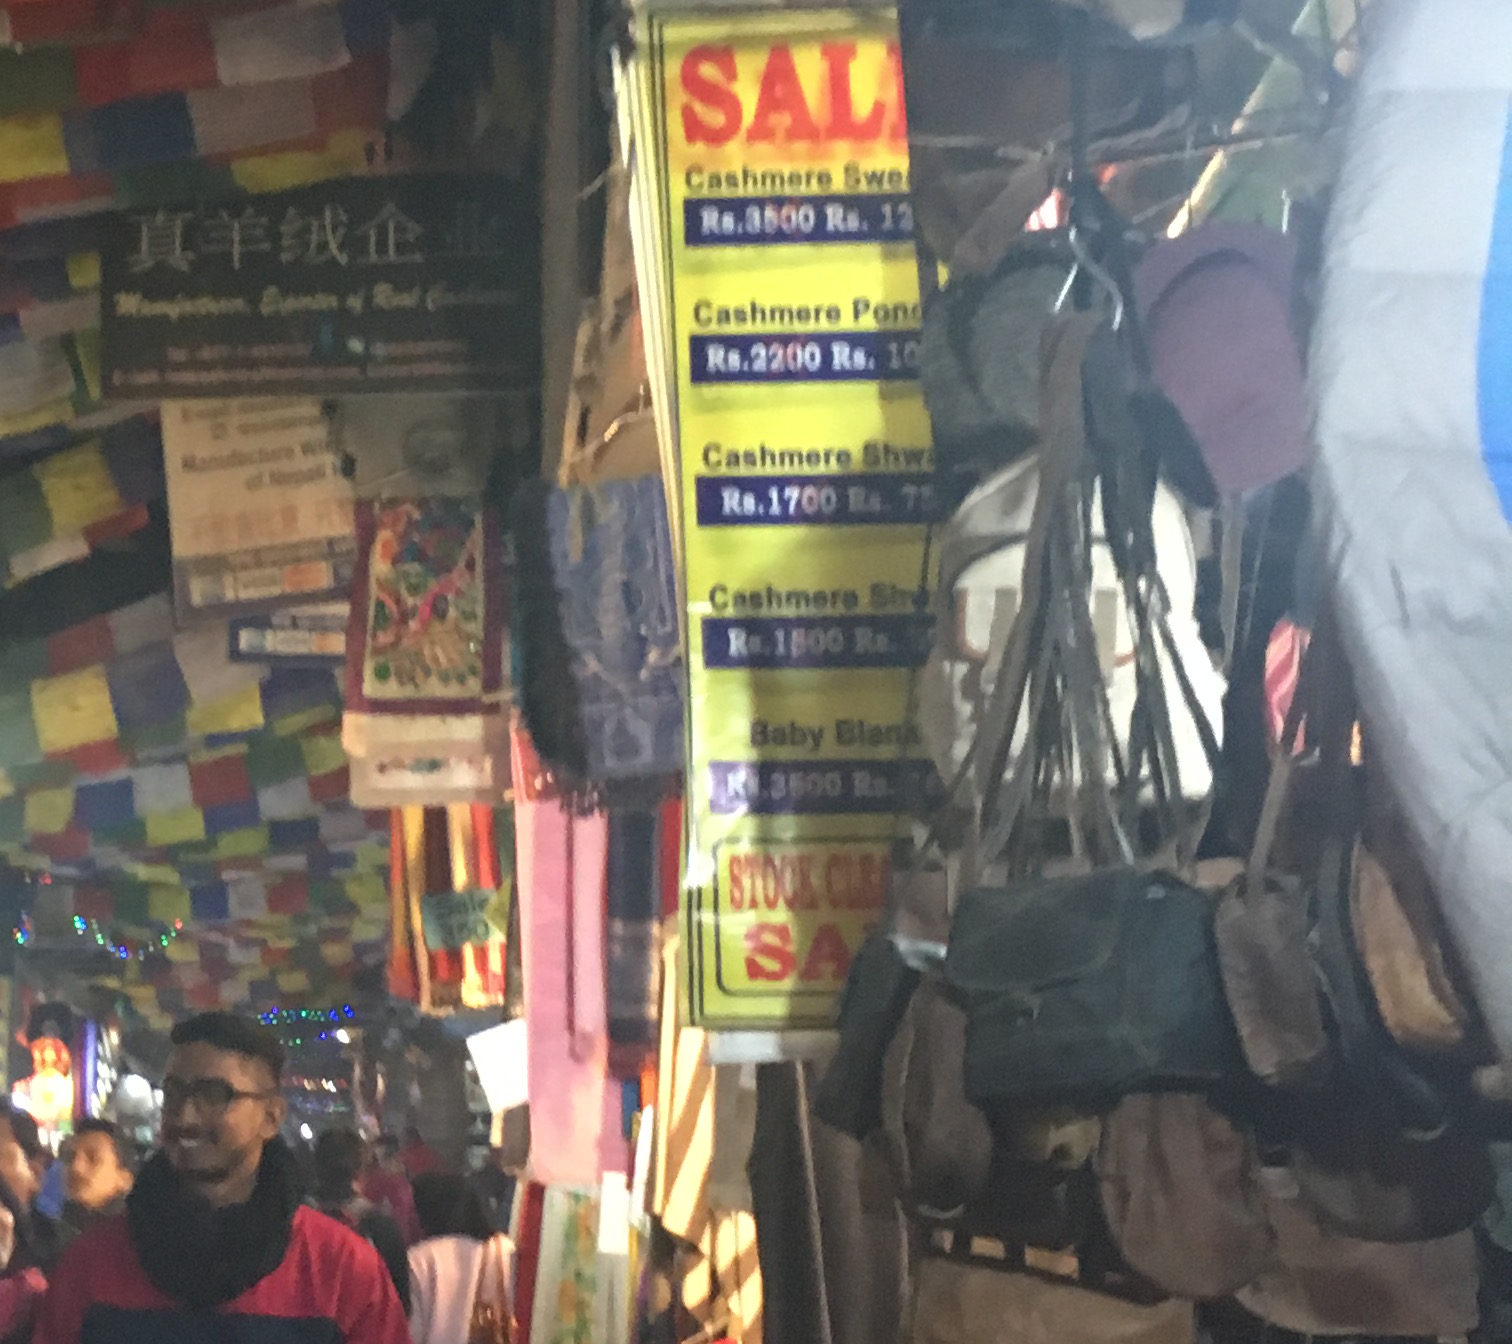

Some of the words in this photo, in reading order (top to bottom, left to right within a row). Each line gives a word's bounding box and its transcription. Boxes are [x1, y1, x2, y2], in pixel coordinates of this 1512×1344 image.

[685, 163, 833, 192] Cashmere
[843, 159, 909, 191] Swe
[693, 297, 841, 328] Cashmere
[701, 441, 852, 470] Cashmere
[720, 484, 838, 517] Rs.1700
[709, 582, 859, 611] Cashmere
[744, 921, 873, 982] SA
